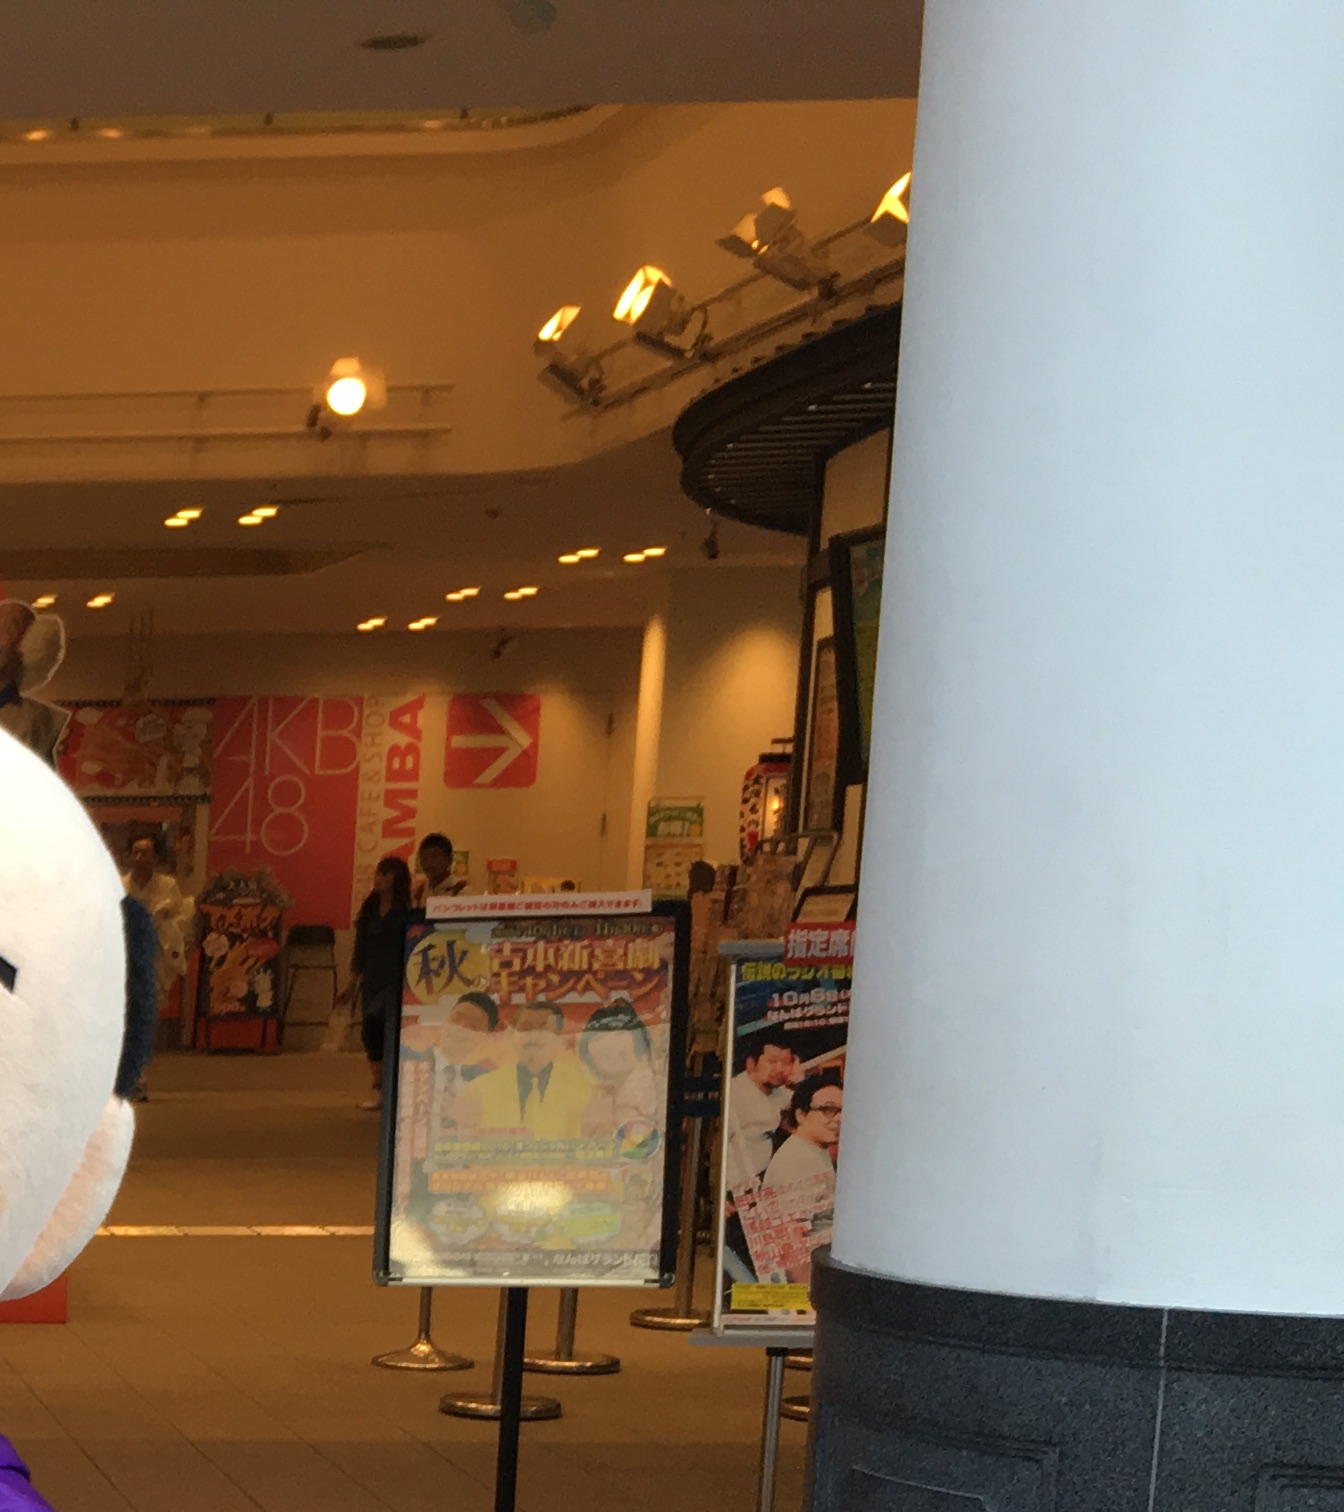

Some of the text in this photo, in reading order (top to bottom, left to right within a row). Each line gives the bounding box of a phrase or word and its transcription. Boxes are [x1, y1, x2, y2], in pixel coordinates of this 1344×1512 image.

[212, 697, 361, 775] AKB
[210, 774, 309, 857] 48
[490, 939, 661, 972] 吉本新喜劇
[787, 928, 855, 958] 指定席
[491, 970, 659, 1000] キャンペーン
